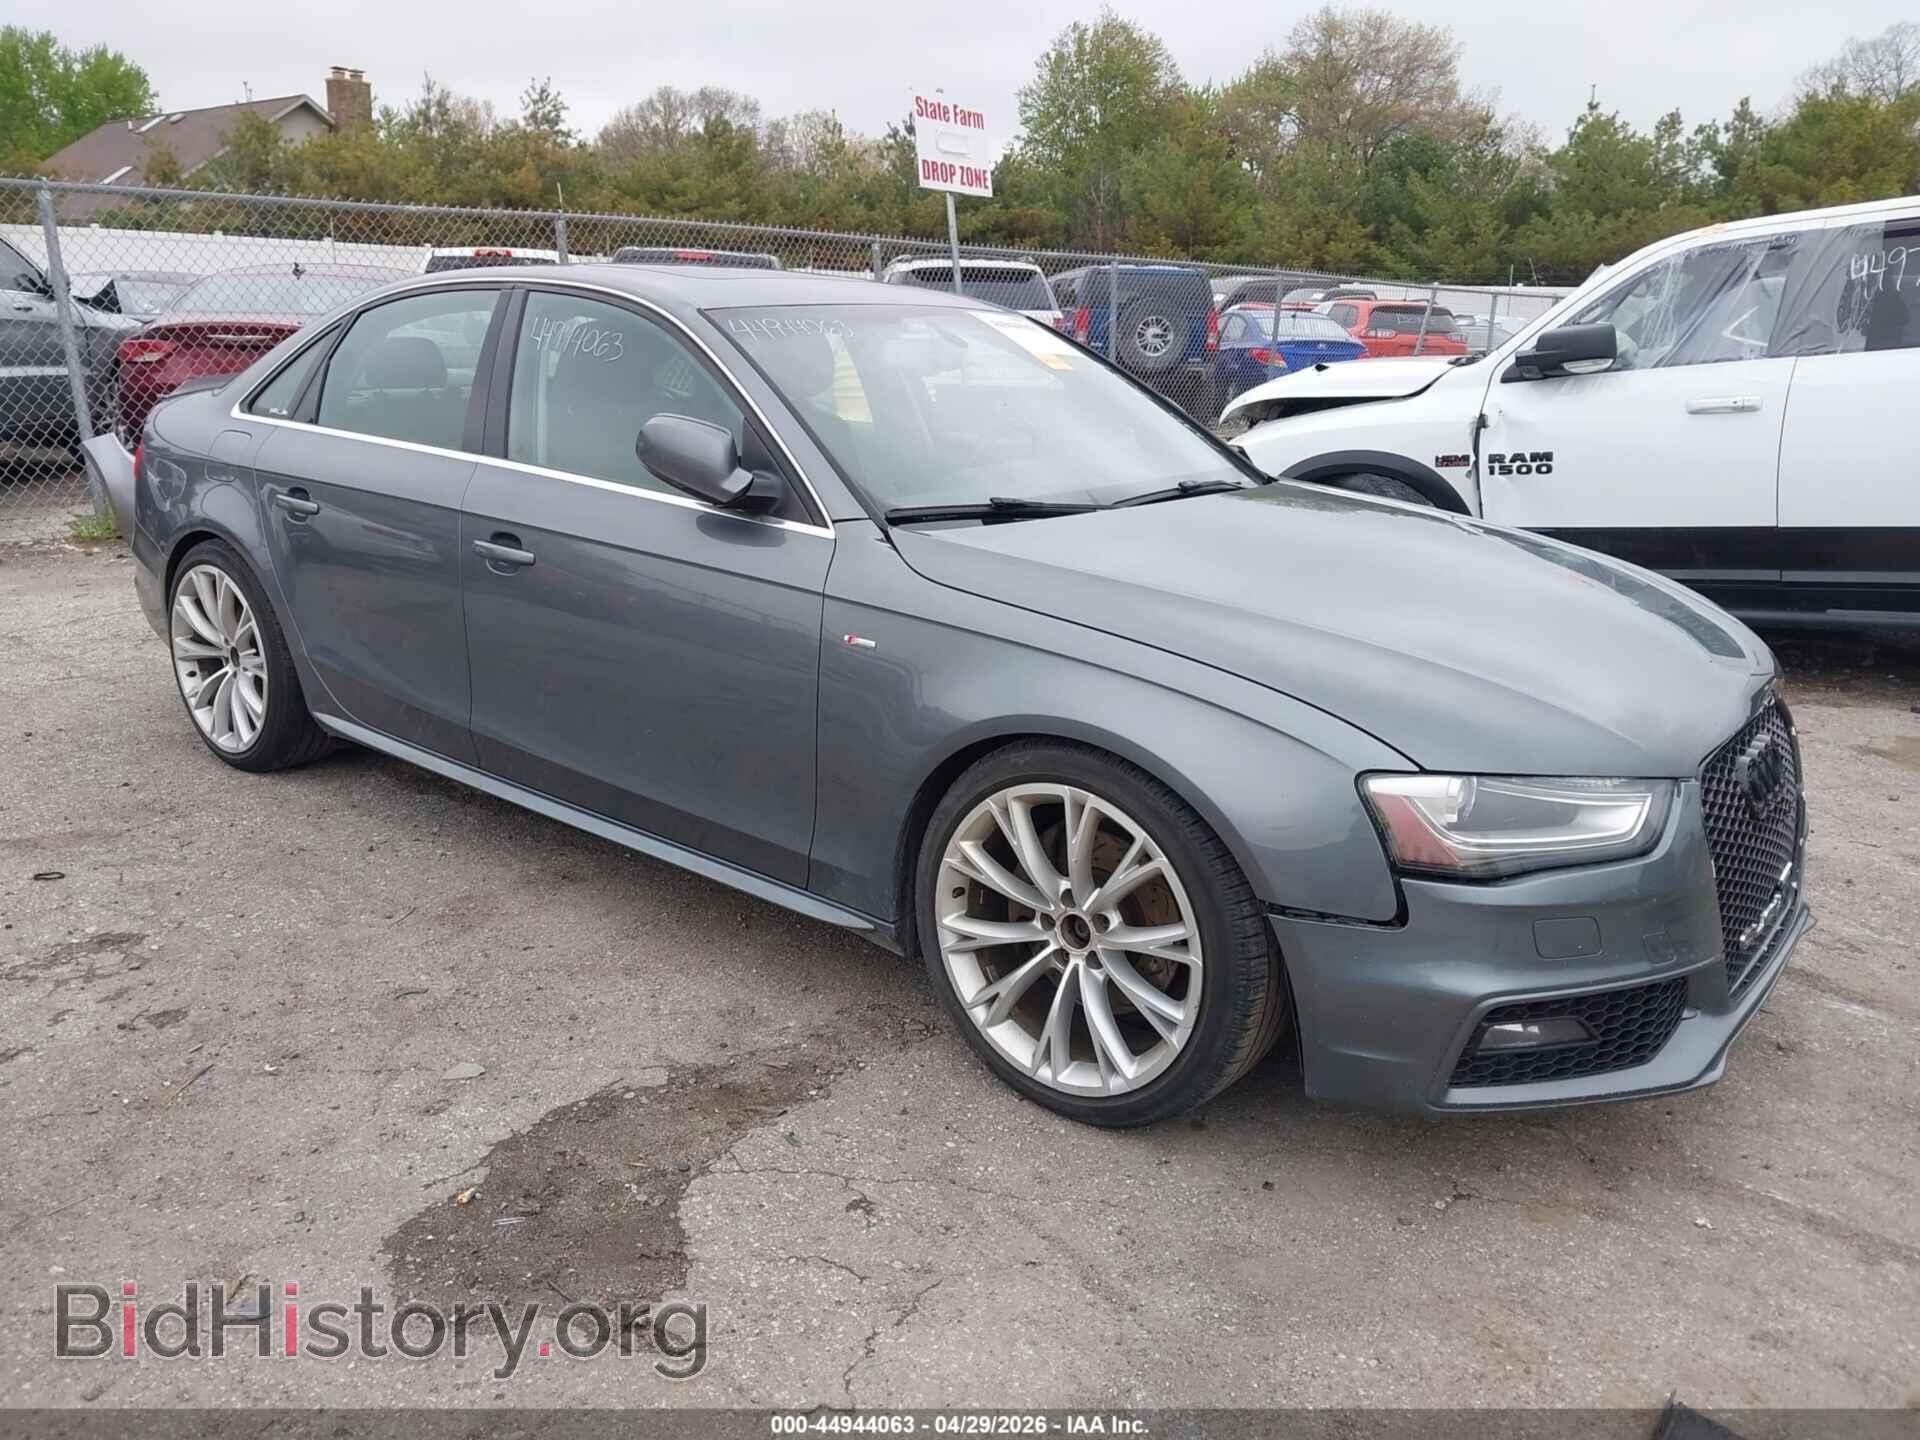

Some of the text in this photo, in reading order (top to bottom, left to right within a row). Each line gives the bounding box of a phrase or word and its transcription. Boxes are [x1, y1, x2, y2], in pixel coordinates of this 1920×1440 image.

[915, 95, 985, 130] State Farm
[922, 159, 989, 190] DROP ZONE
[1487, 451, 1554, 464] RAM
[1487, 463, 1554, 476] 1500
